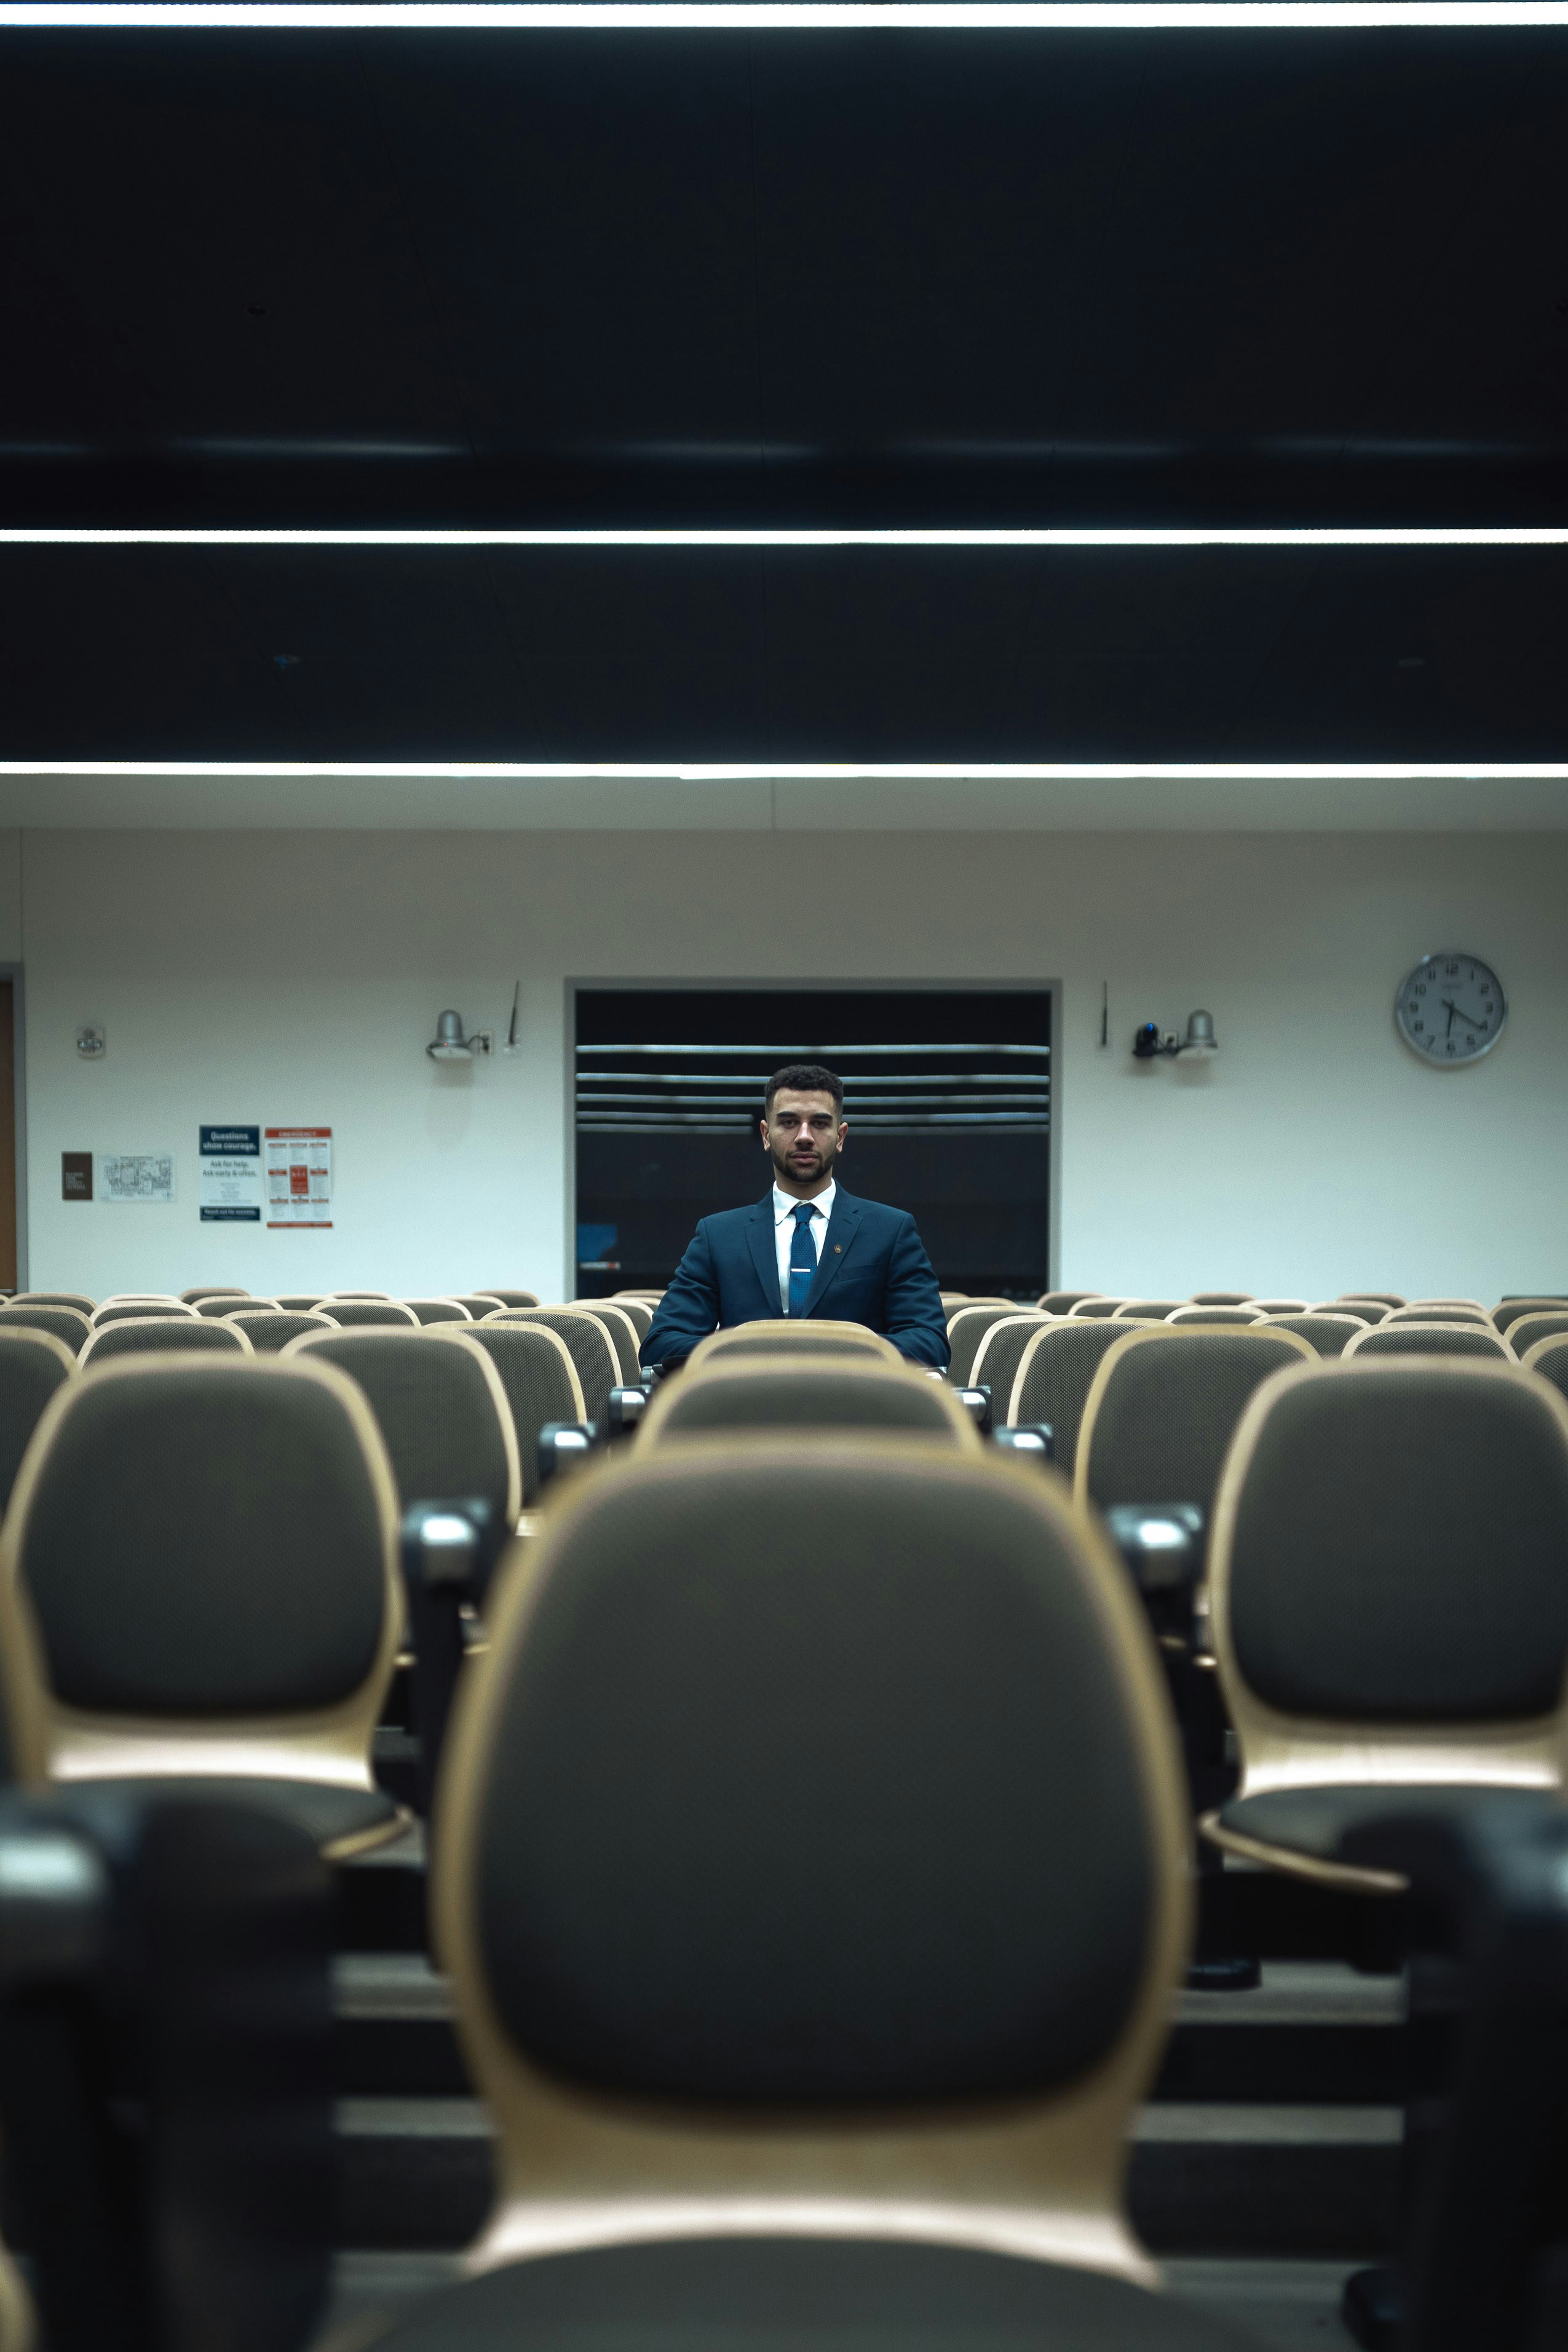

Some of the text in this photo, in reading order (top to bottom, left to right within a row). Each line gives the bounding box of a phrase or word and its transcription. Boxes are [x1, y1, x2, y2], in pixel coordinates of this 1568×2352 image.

[1446, 964, 1459, 975] 12
[1471, 970, 1474, 980] 1
[1428, 970, 1436, 981] 11
[1415, 983, 1427, 995] 10
[1480, 983, 1489, 995] 2
[1409, 1002, 1419, 1013] 9
[1486, 1001, 1494, 1013] 3
[1414, 1020, 1423, 1032] 8
[1427, 1035, 1436, 1047] 7
[1447, 1040, 1455, 1051] 6
[1467, 1034, 1475, 1047] 5
[210, 1131, 248, 1141] Questions
[202, 1141, 222, 1150] show
[223, 1142, 256, 1152] courage.
